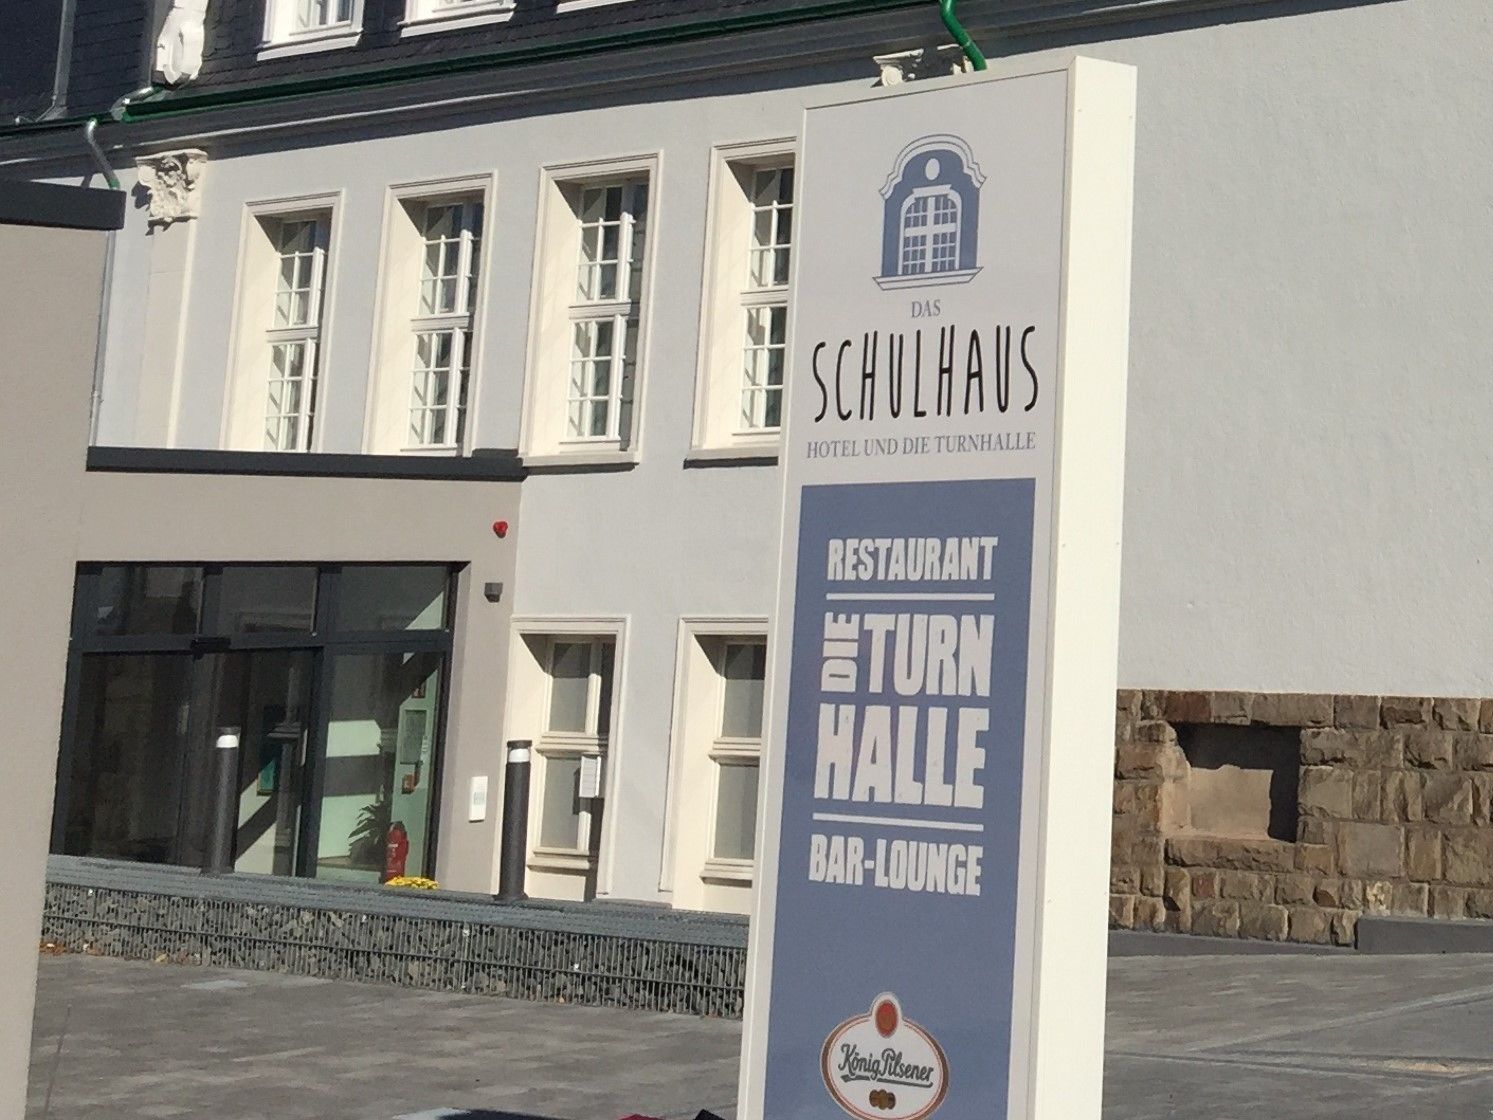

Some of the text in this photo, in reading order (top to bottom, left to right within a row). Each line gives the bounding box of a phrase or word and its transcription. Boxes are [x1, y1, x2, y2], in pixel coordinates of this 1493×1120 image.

[911, 299, 940, 318] DAS
[812, 324, 1039, 423] SCHULHAUS
[806, 432, 1036, 459] HOTEL UND DIE TURNHALLE
[827, 536, 999, 582] RESTAURANT
[821, 611, 859, 693] DIE
[864, 614, 994, 697] TURN
[814, 703, 990, 809] HALLE
[810, 834, 983, 896] BAR-LOUNGE
[839, 1044, 933, 1082] König Pilsener
